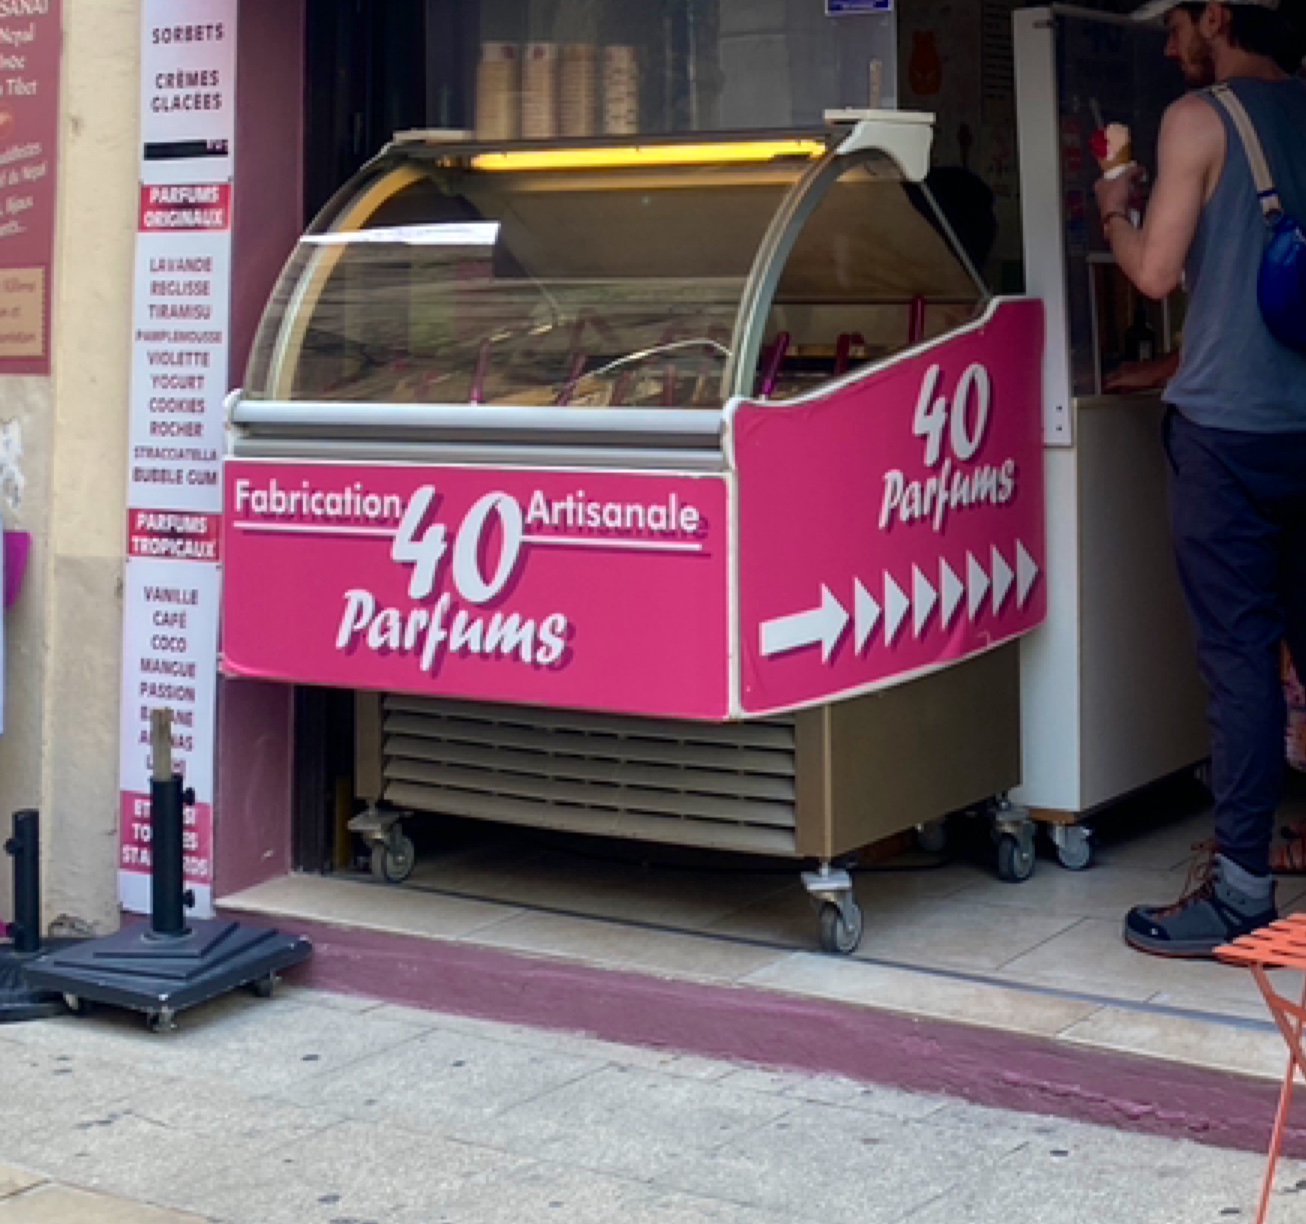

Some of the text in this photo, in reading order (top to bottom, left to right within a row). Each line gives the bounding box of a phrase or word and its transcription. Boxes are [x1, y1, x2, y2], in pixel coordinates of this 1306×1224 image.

[152, 22, 225, 44] SORBETS
[150, 186, 220, 203] PARFUMS
[150, 256, 213, 272] LAVANDE
[147, 304, 211, 320] TIRAMISU
[147, 350, 210, 367] VIOLETTE
[149, 397, 205, 413] COOKIES
[912, 362, 991, 467] 40
[149, 421, 203, 437] ROCHER
[133, 467, 218, 485] BUBBLE GUM
[878, 457, 1016, 533] Parfums
[234, 479, 701, 533] Fabrication Artisanale
[136, 512, 208, 534] PARFUMS
[132, 535, 215, 558] TROPICAUX
[391, 484, 525, 604] 40
[144, 587, 198, 605] VANILLE
[335, 589, 570, 672] Parfums
[151, 634, 187, 652] COCO
[140, 657, 196, 679] MANGUE
[139, 682, 196, 701] PASSION
[131, 823, 198, 851] TOES
